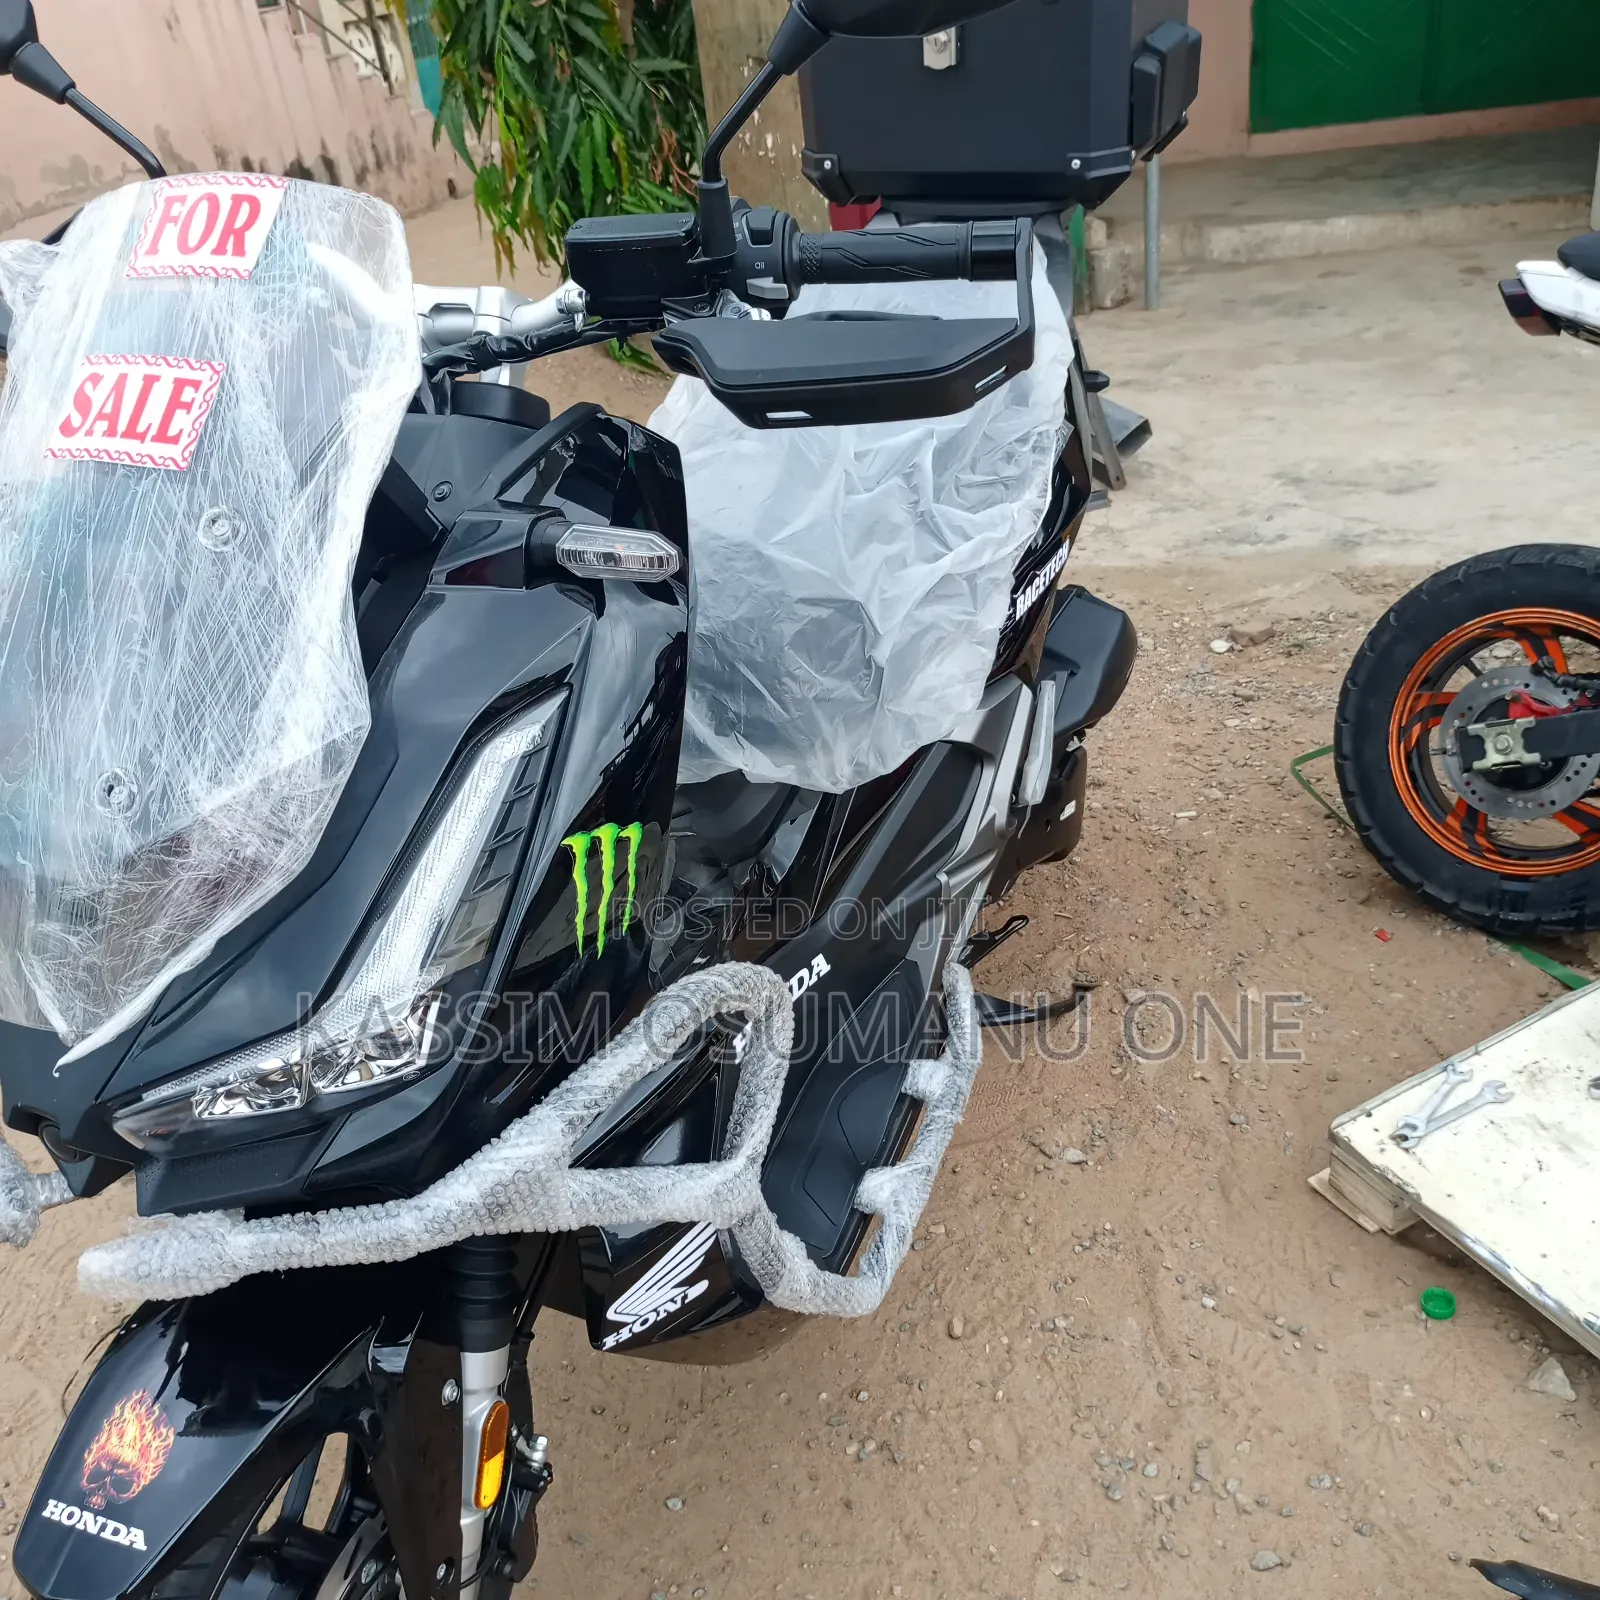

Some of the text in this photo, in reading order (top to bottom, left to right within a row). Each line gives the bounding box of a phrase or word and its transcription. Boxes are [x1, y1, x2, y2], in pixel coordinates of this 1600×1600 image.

[144, 191, 262, 258] FOR
[57, 371, 203, 446] SALE
[1015, 534, 1070, 621] RACETECH
[41, 1498, 148, 1551] HONDA
